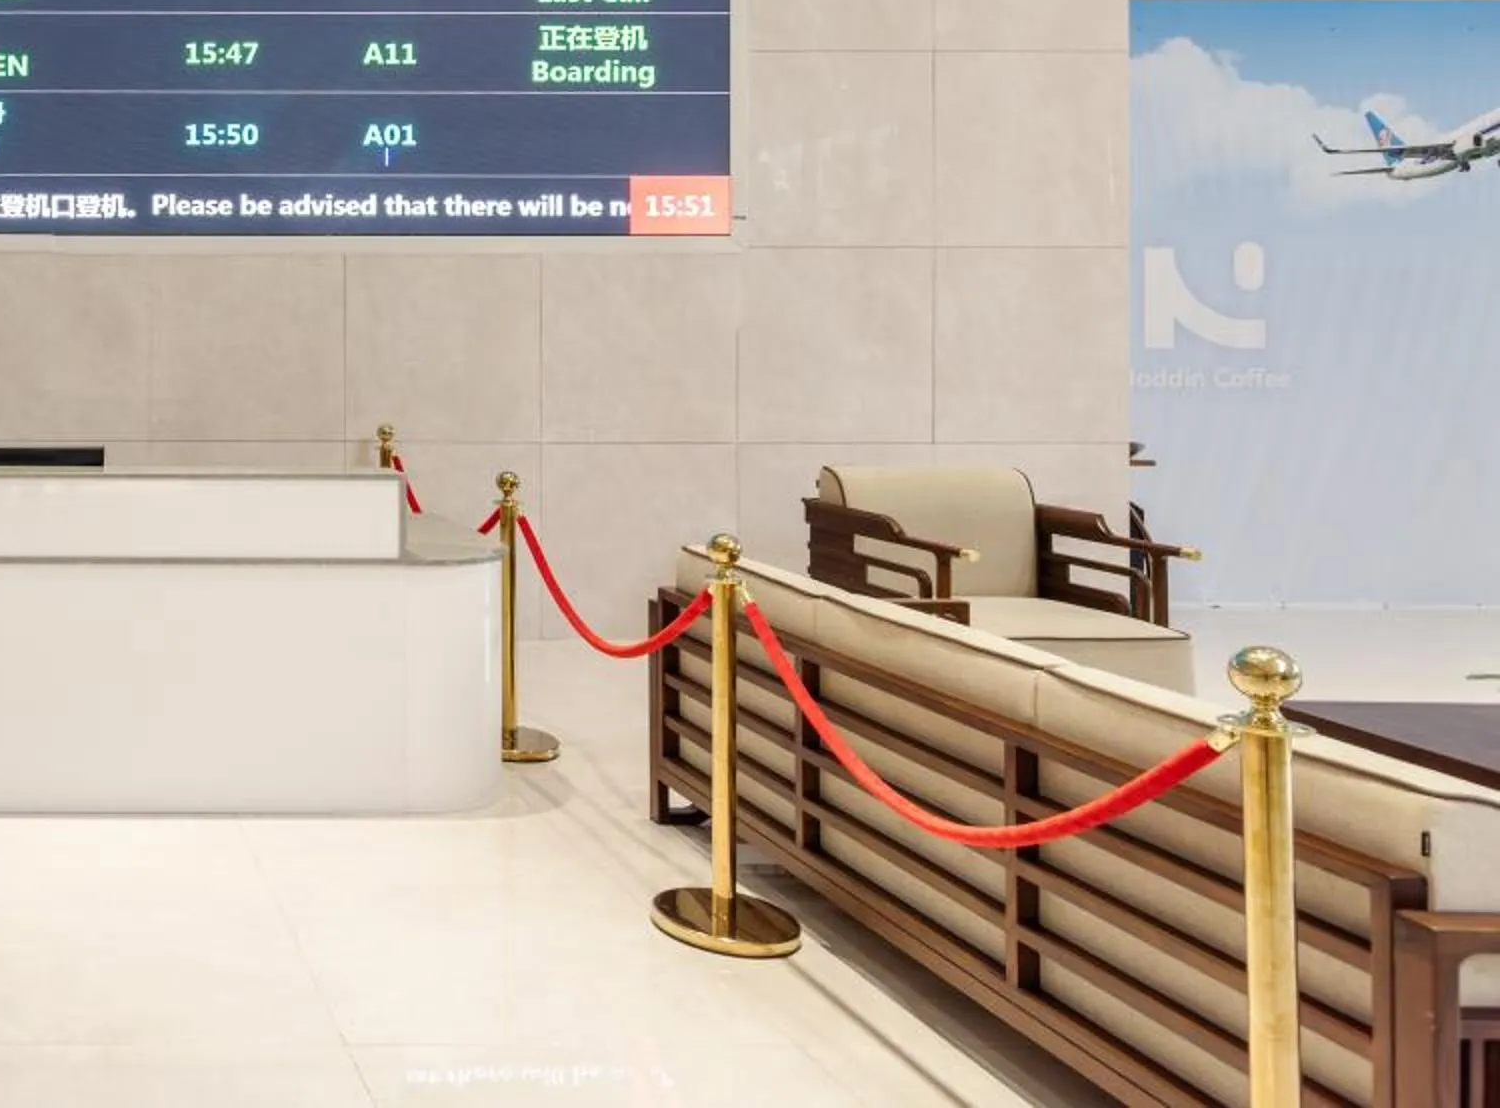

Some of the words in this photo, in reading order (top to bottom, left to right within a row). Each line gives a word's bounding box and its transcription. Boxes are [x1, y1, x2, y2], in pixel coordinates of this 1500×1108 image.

[539, 25, 648, 51] 正在登机
[185, 42, 259, 65] 15:47
[363, 42, 417, 65] A11
[531, 59, 655, 89] Boarding
[185, 123, 259, 146] 15:50
[363, 123, 417, 146] A01
[152, 193, 233, 216] Please
[239, 193, 273, 216] be
[278, 193, 378, 217] advised
[383, 193, 438, 216] that
[443, 194, 513, 217] there
[517, 194, 564, 217] will
[570, 194, 604, 217] be
[646, 195, 716, 217] 15:51
